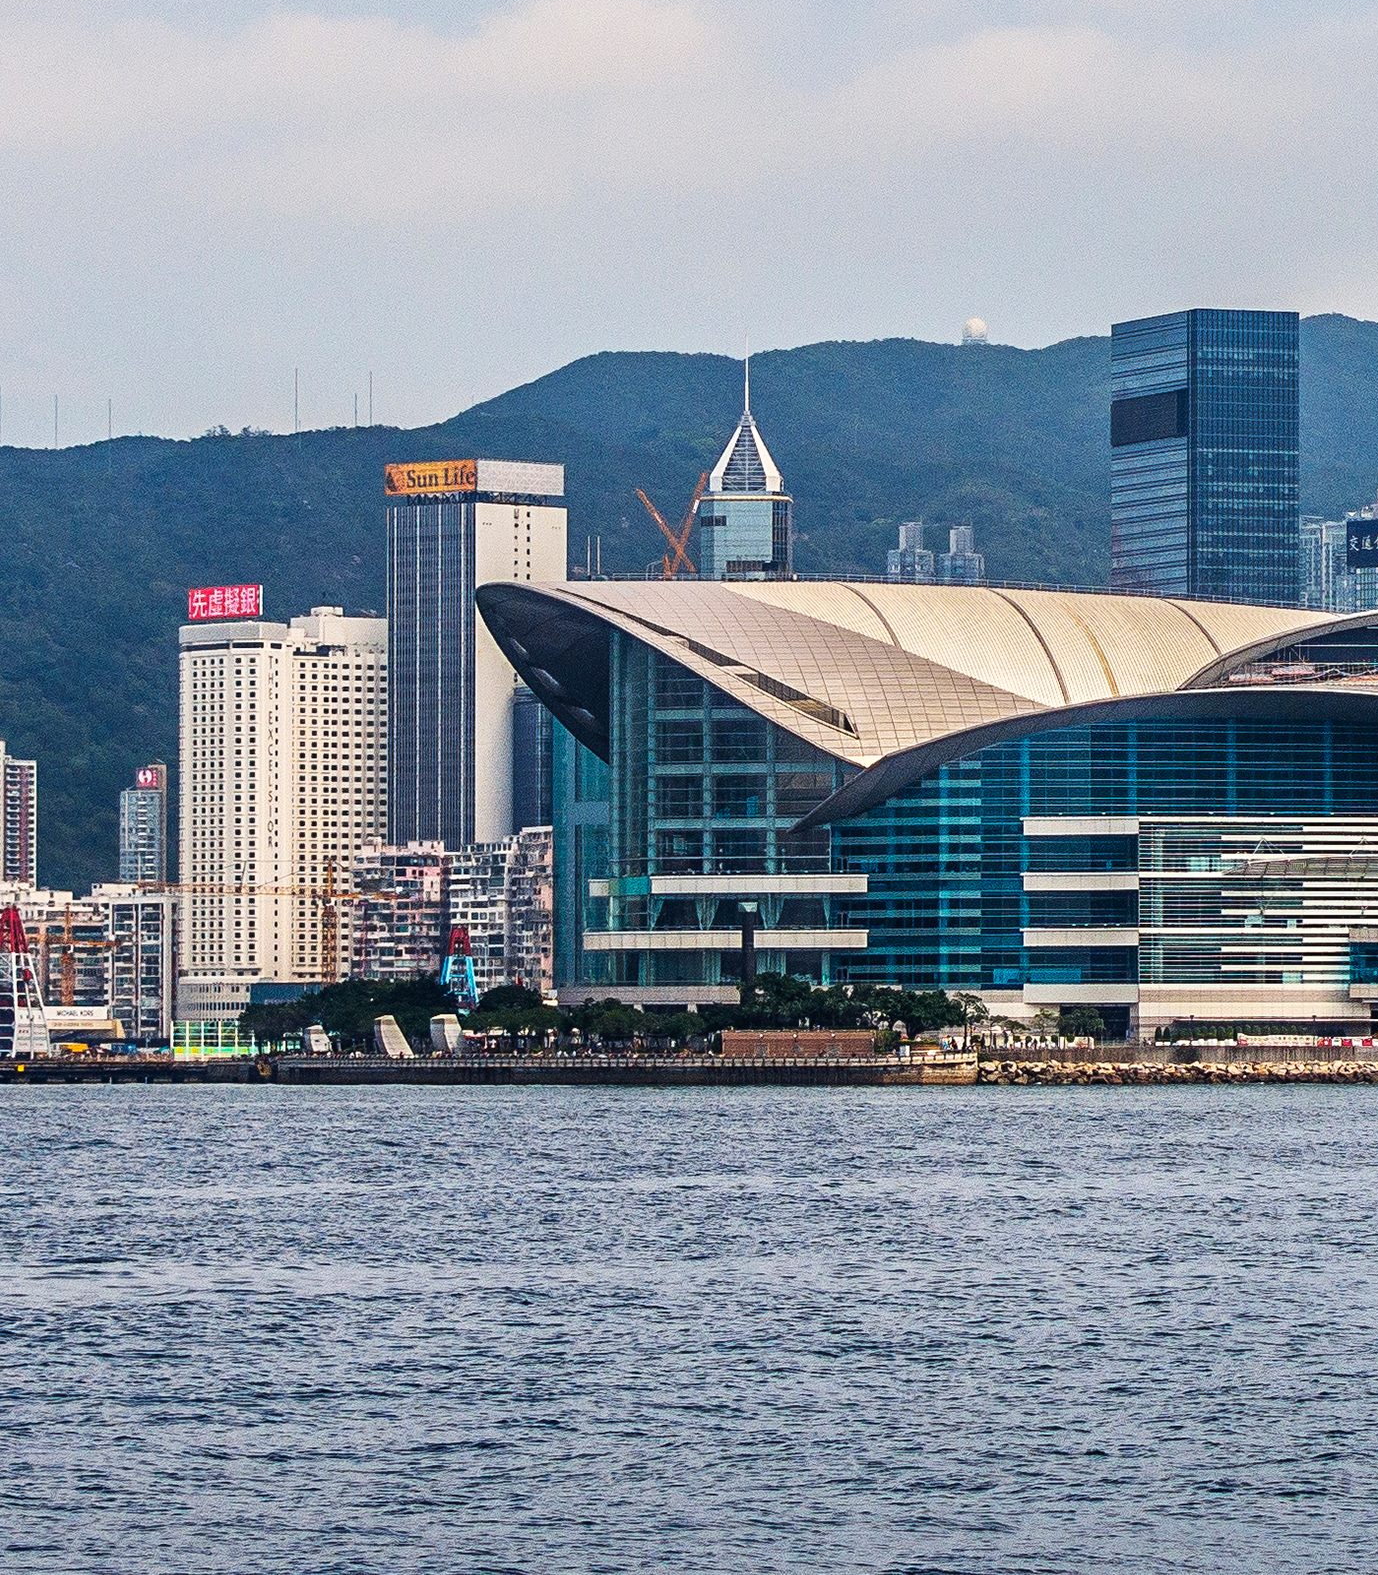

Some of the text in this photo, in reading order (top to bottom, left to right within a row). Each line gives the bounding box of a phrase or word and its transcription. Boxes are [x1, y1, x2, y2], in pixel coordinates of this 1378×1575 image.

[406, 465, 475, 488] Sun Life
[188, 587, 260, 618] 先虛擬銀
[267, 711, 275, 848] EXCELSIOR
